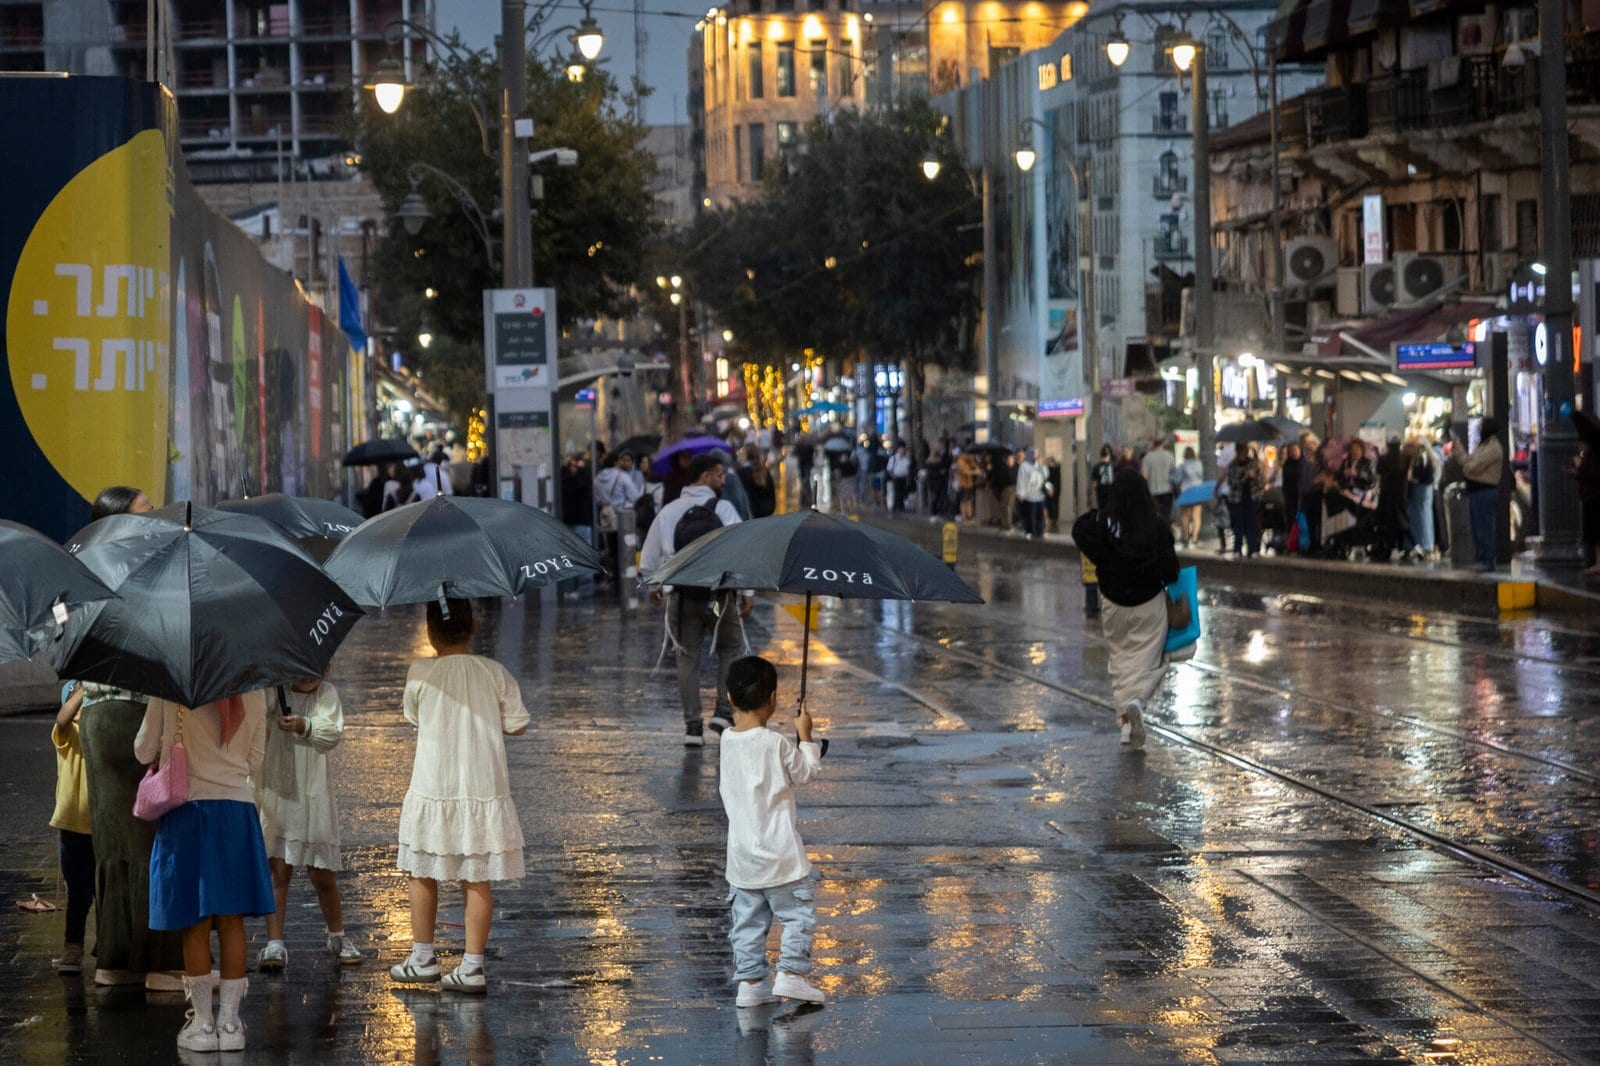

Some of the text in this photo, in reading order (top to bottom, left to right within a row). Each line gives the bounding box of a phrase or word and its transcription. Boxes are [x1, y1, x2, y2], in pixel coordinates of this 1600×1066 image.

[520, 555, 573, 578] ZOYä
[803, 567, 873, 585] ZOYä
[309, 601, 343, 646] ZOYä
